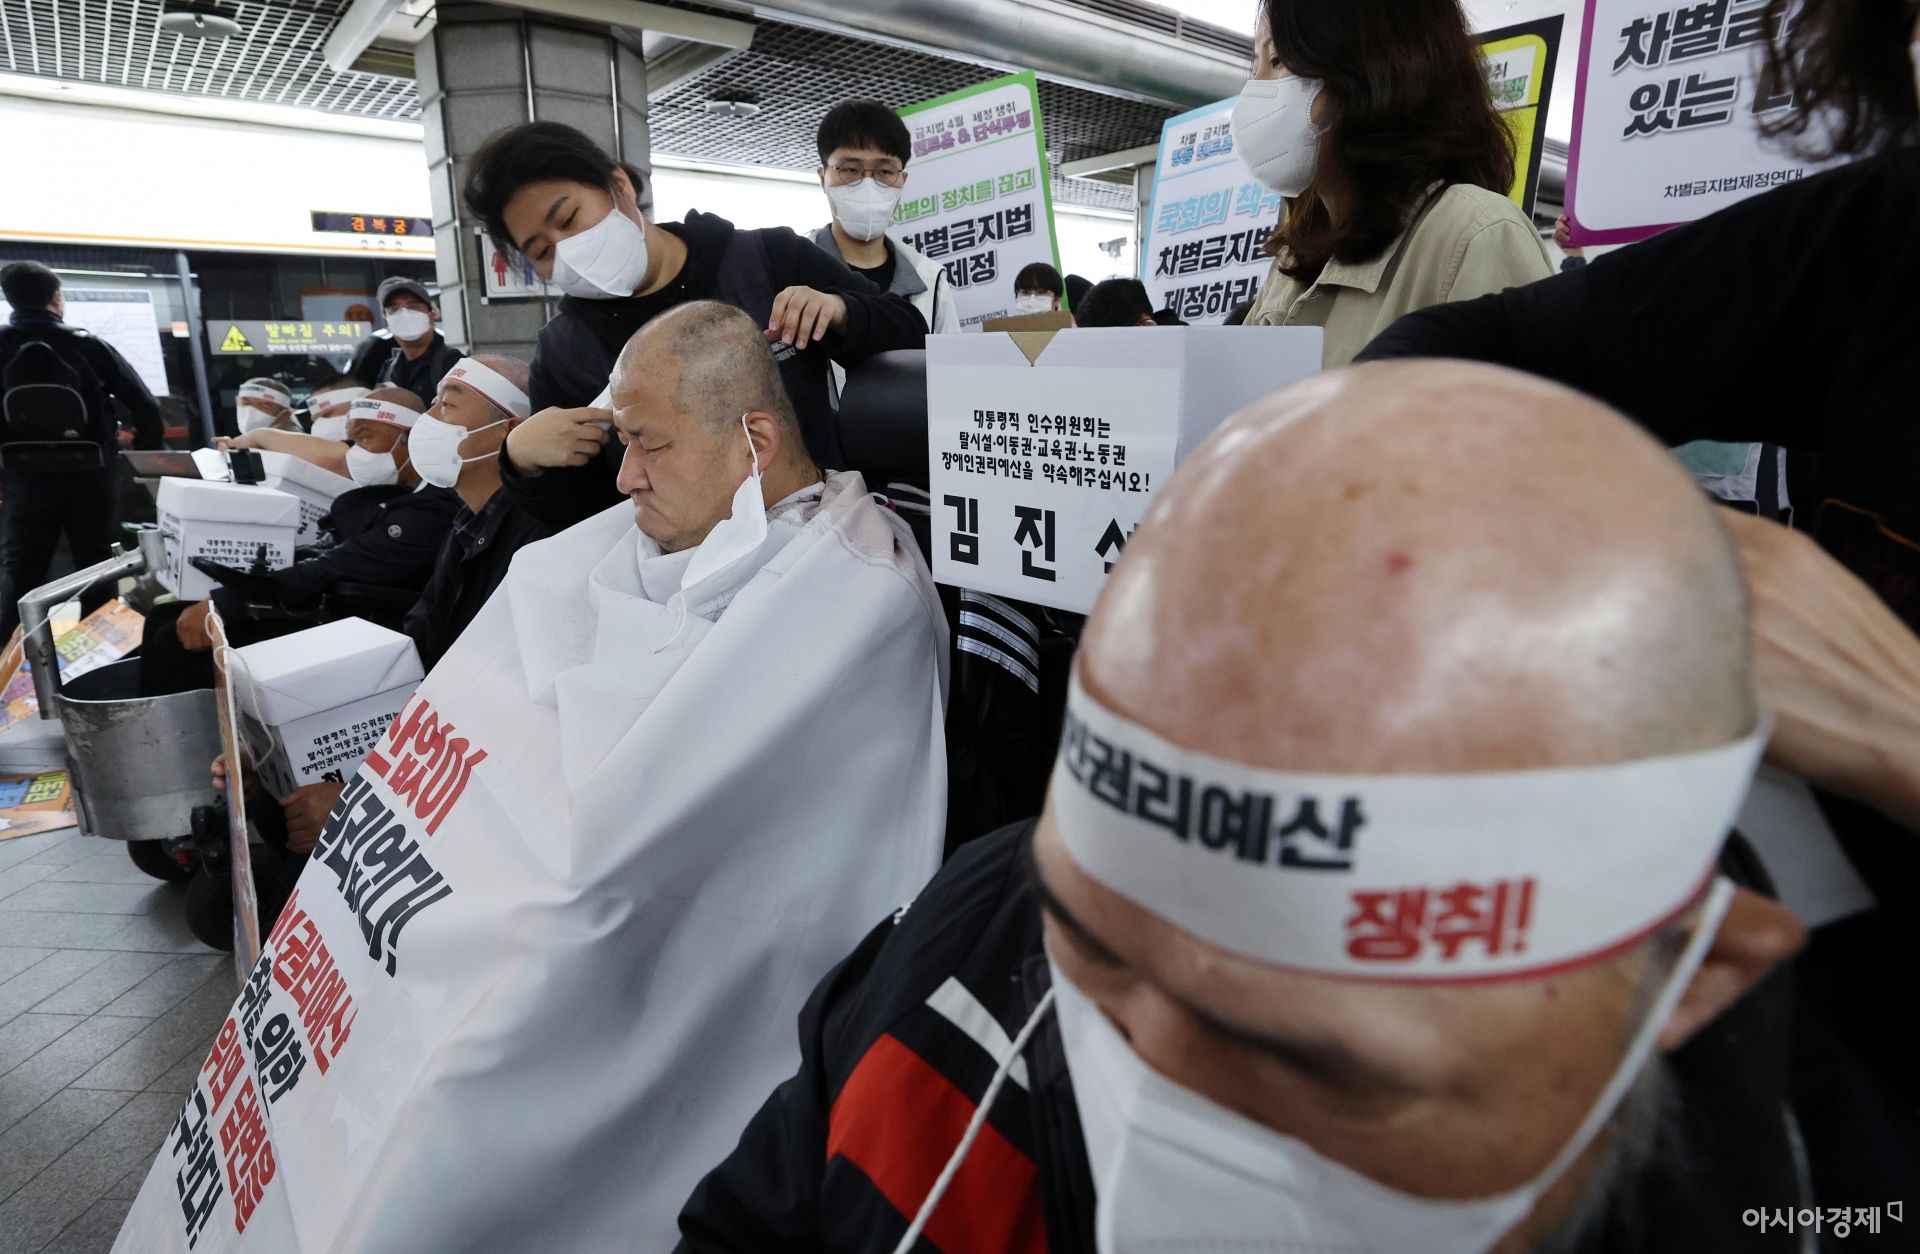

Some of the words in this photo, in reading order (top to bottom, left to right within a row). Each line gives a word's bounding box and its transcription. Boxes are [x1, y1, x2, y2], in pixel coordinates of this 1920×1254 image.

[995, 101, 1016, 116] 쟁취
[1623, 74, 1737, 136] 있는
[958, 127, 971, 144] &
[942, 178, 993, 210] 정치를
[998, 168, 1034, 195] 끊고
[1664, 168, 1803, 198] 차별금지법제정연대
[1157, 186, 1232, 233] 국회의
[943, 250, 996, 287] 제정
[265, 323, 312, 338] 발빠짐
[322, 323, 361, 338] 주의!
[974, 410, 1020, 431] 대통령직
[1028, 413, 1110, 439] 인수위원회는
[959, 431, 1126, 466] 탈시설·이동권·교육권·노동권
[942, 451, 1033, 480] 장애인권리예산을
[1042, 462, 1149, 492] 약속해주십시오!
[1346, 875, 1536, 961] 쟁취!
[219, 1075, 276, 1235] 답변을
